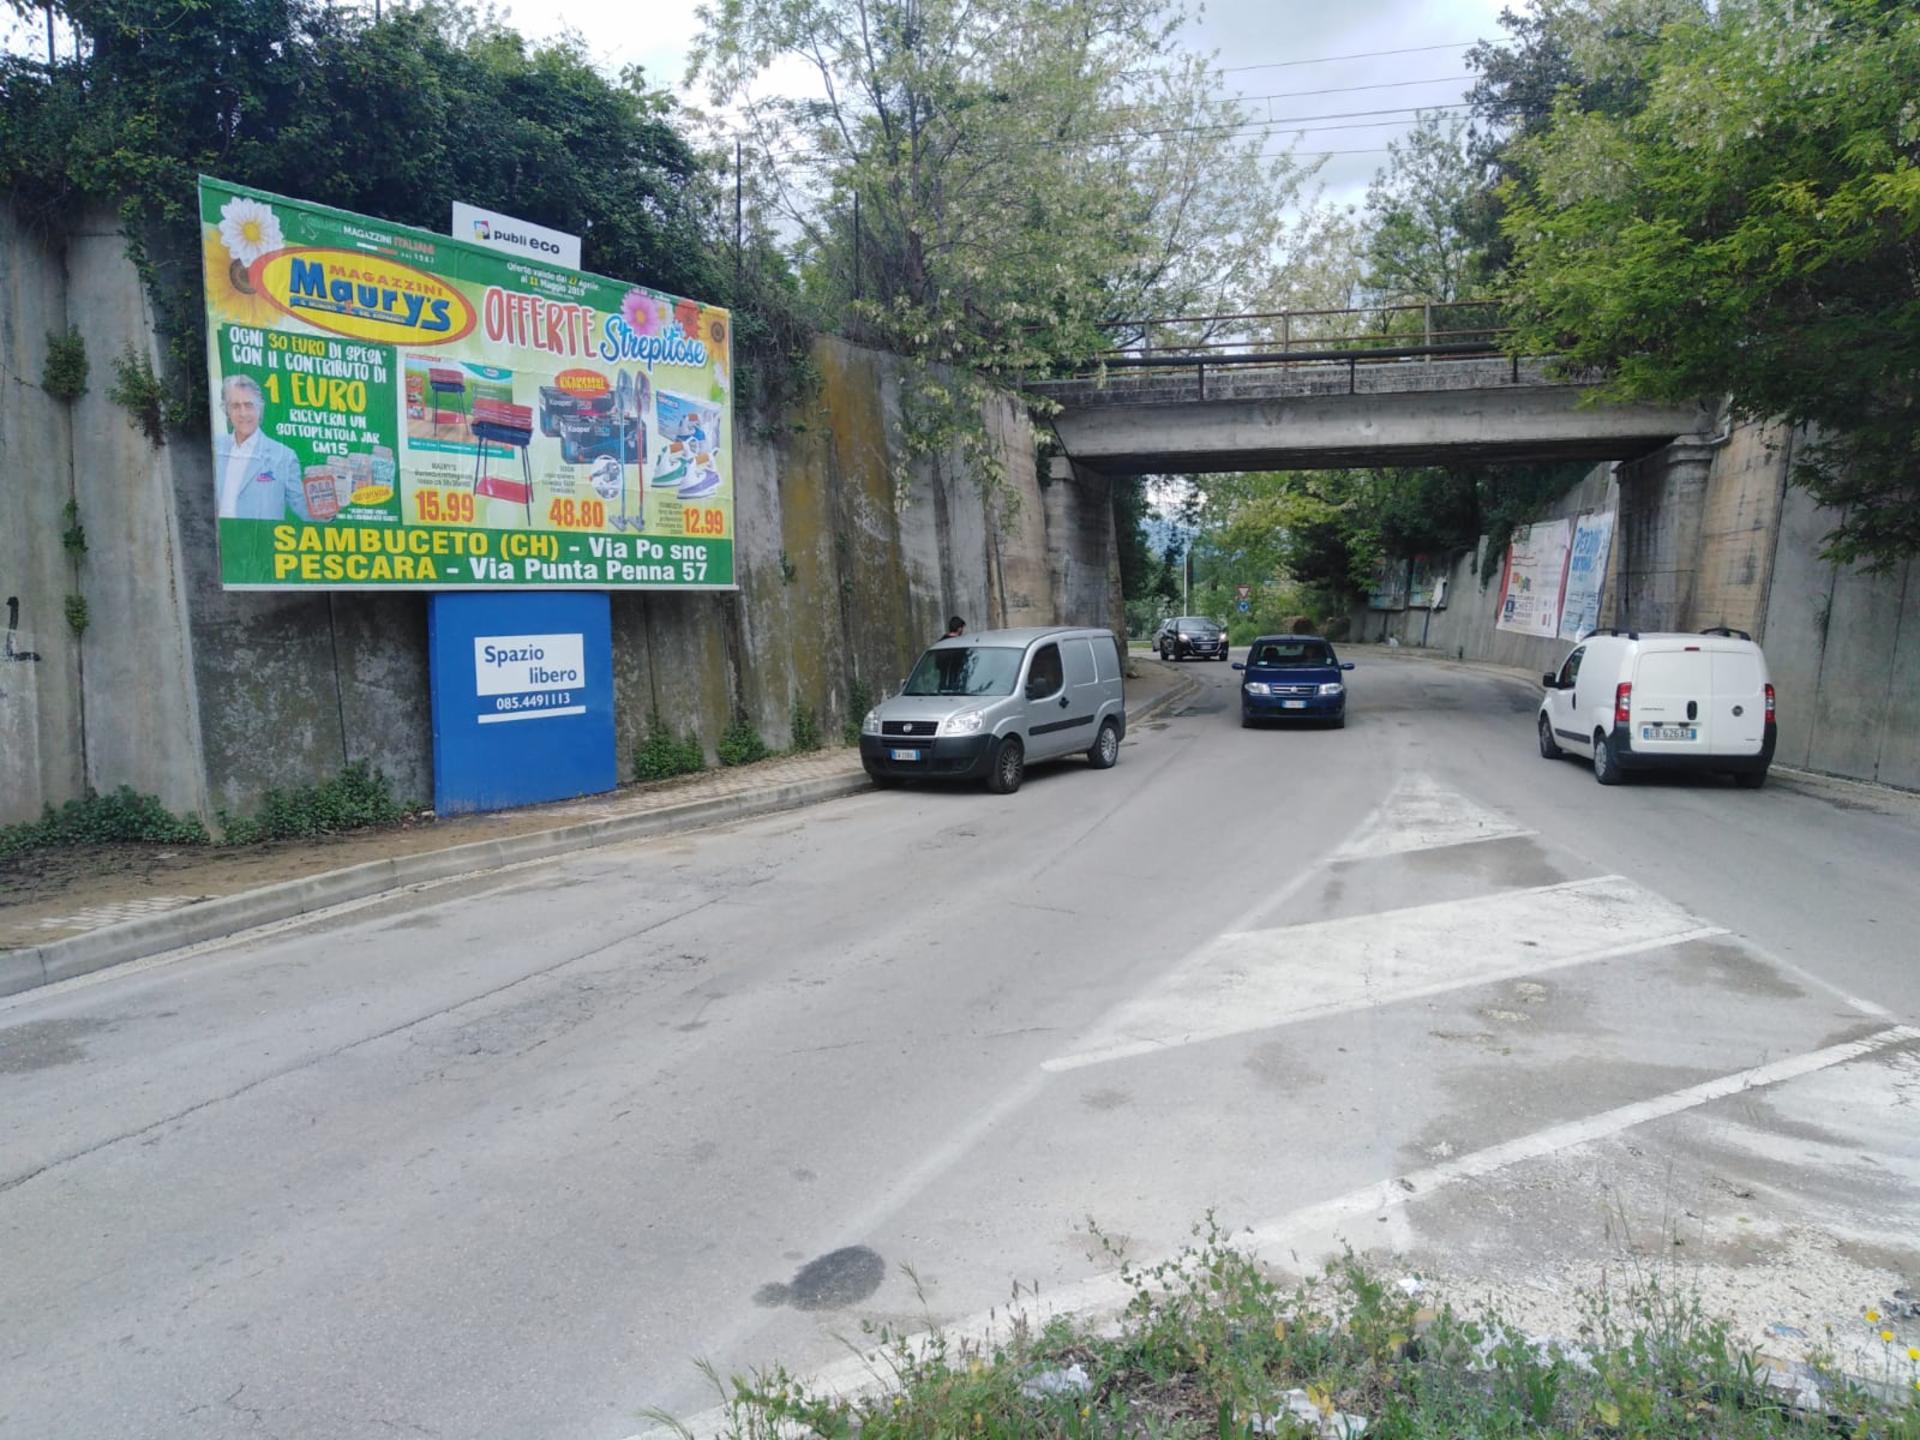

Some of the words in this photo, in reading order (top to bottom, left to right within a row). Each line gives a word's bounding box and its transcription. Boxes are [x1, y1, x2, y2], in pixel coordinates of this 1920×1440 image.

[343, 225, 392, 245] MAGAZZINI
[494, 229, 527, 246] publi
[529, 236, 560, 255] eco
[289, 257, 451, 332] Maury's
[329, 264, 443, 297] MAGAZZINI
[483, 287, 598, 358] OFFERTE
[229, 326, 263, 348] OGNI
[268, 332, 287, 350] 30
[292, 335, 326, 357] EURO
[328, 341, 341, 359] DI
[600, 314, 706, 371] Strepitose
[231, 344, 262, 367] CON
[268, 350, 279, 369] IL
[285, 352, 369, 381] CONTRIBUTO
[374, 366, 387, 384] DI
[264, 373, 280, 404] 1
[290, 372, 367, 413] EURO
[349, 414, 367, 430] UN
[312, 440, 348, 456] CM15
[415, 490, 475, 523] 15.99
[549, 498, 604, 528] 48.80
[683, 508, 724, 535] 12.99
[273, 525, 488, 555] SAMBUCETO
[500, 533, 559, 561] (CH)
[588, 537, 628, 559] Via
[636, 539, 664, 559] Po
[670, 545, 707, 561] snc
[273, 553, 437, 579] PESCARA
[468, 557, 515, 580] Via
[525, 557, 599, 580] Punta
[606, 560, 675, 581] Penna
[682, 562, 708, 582] 57
[484, 644, 545, 668] Spazio
[529, 667, 577, 684] libero
[496, 692, 571, 711] 085.4491113
